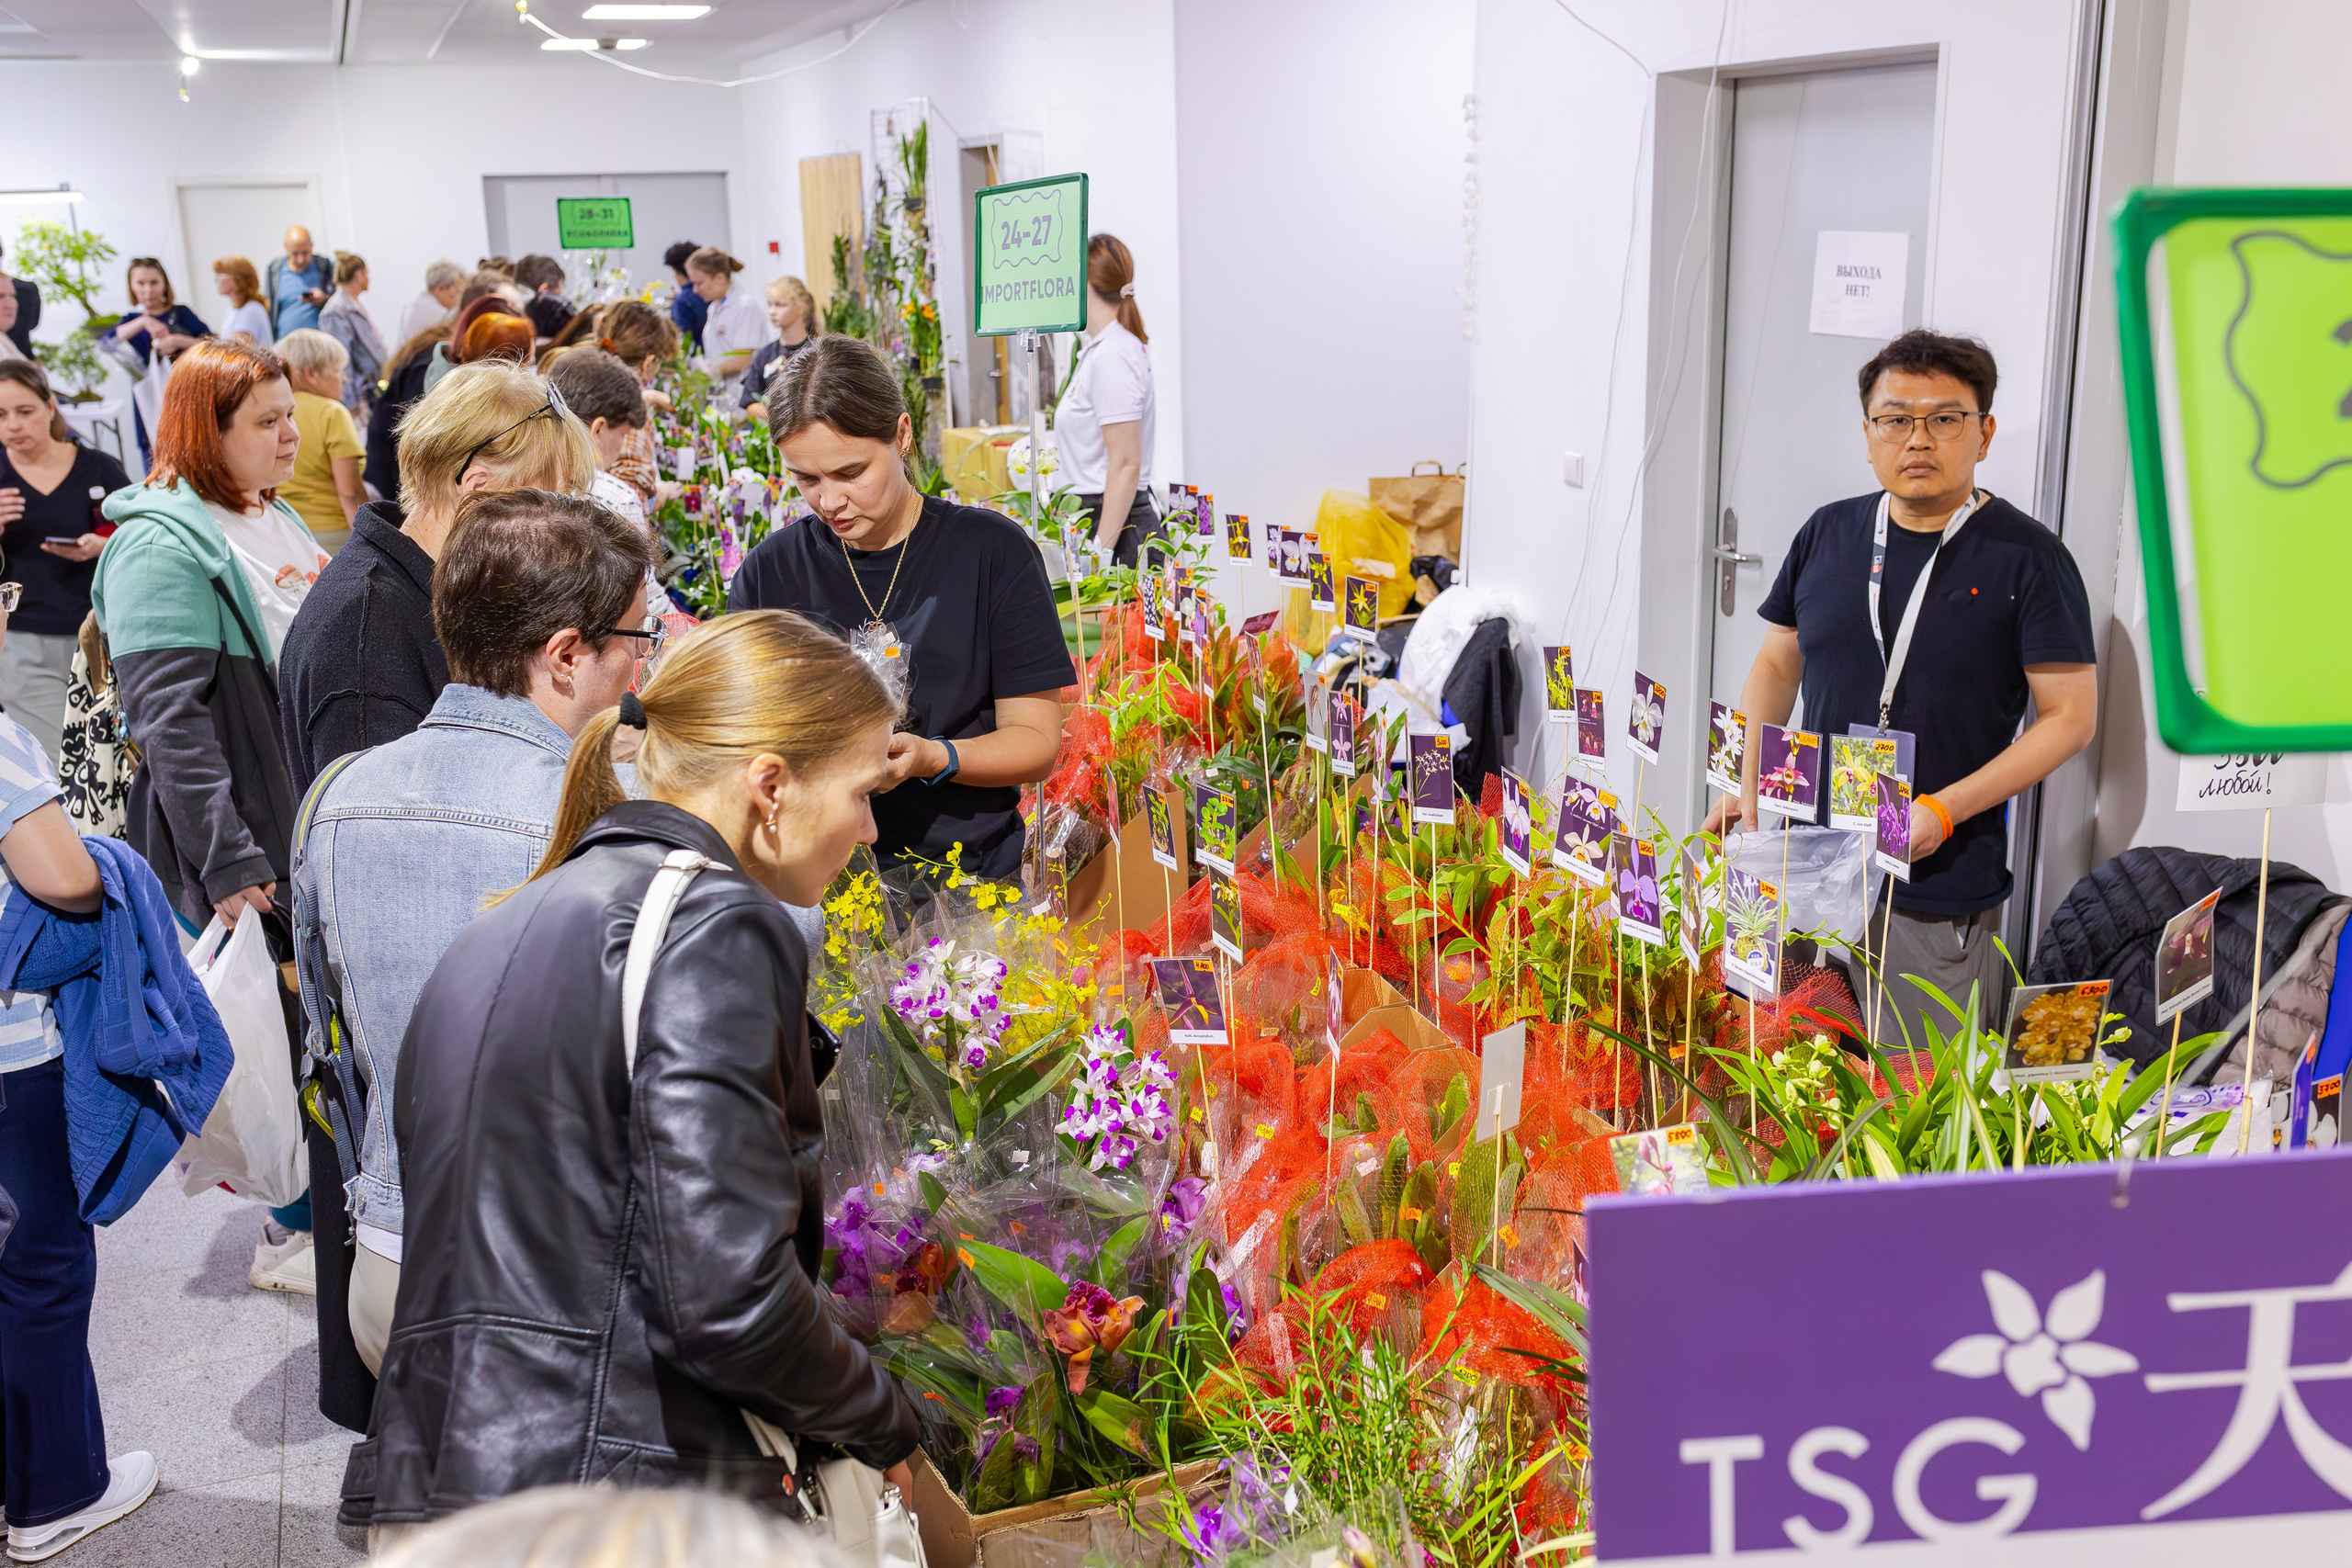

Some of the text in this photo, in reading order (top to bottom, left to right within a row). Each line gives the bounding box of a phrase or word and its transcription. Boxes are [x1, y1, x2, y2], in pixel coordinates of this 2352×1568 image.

[1001, 214, 1052, 251] 24-27
[1836, 265, 1883, 280] ВЫХОДА
[980, 276, 1076, 305] IMPORTFLORA
[1845, 284, 1871, 298] НЕТ!
[1874, 742, 1894, 752] 2700
[2199, 769, 2272, 798] любой!
[1679, 1416, 2039, 1554] TSG
